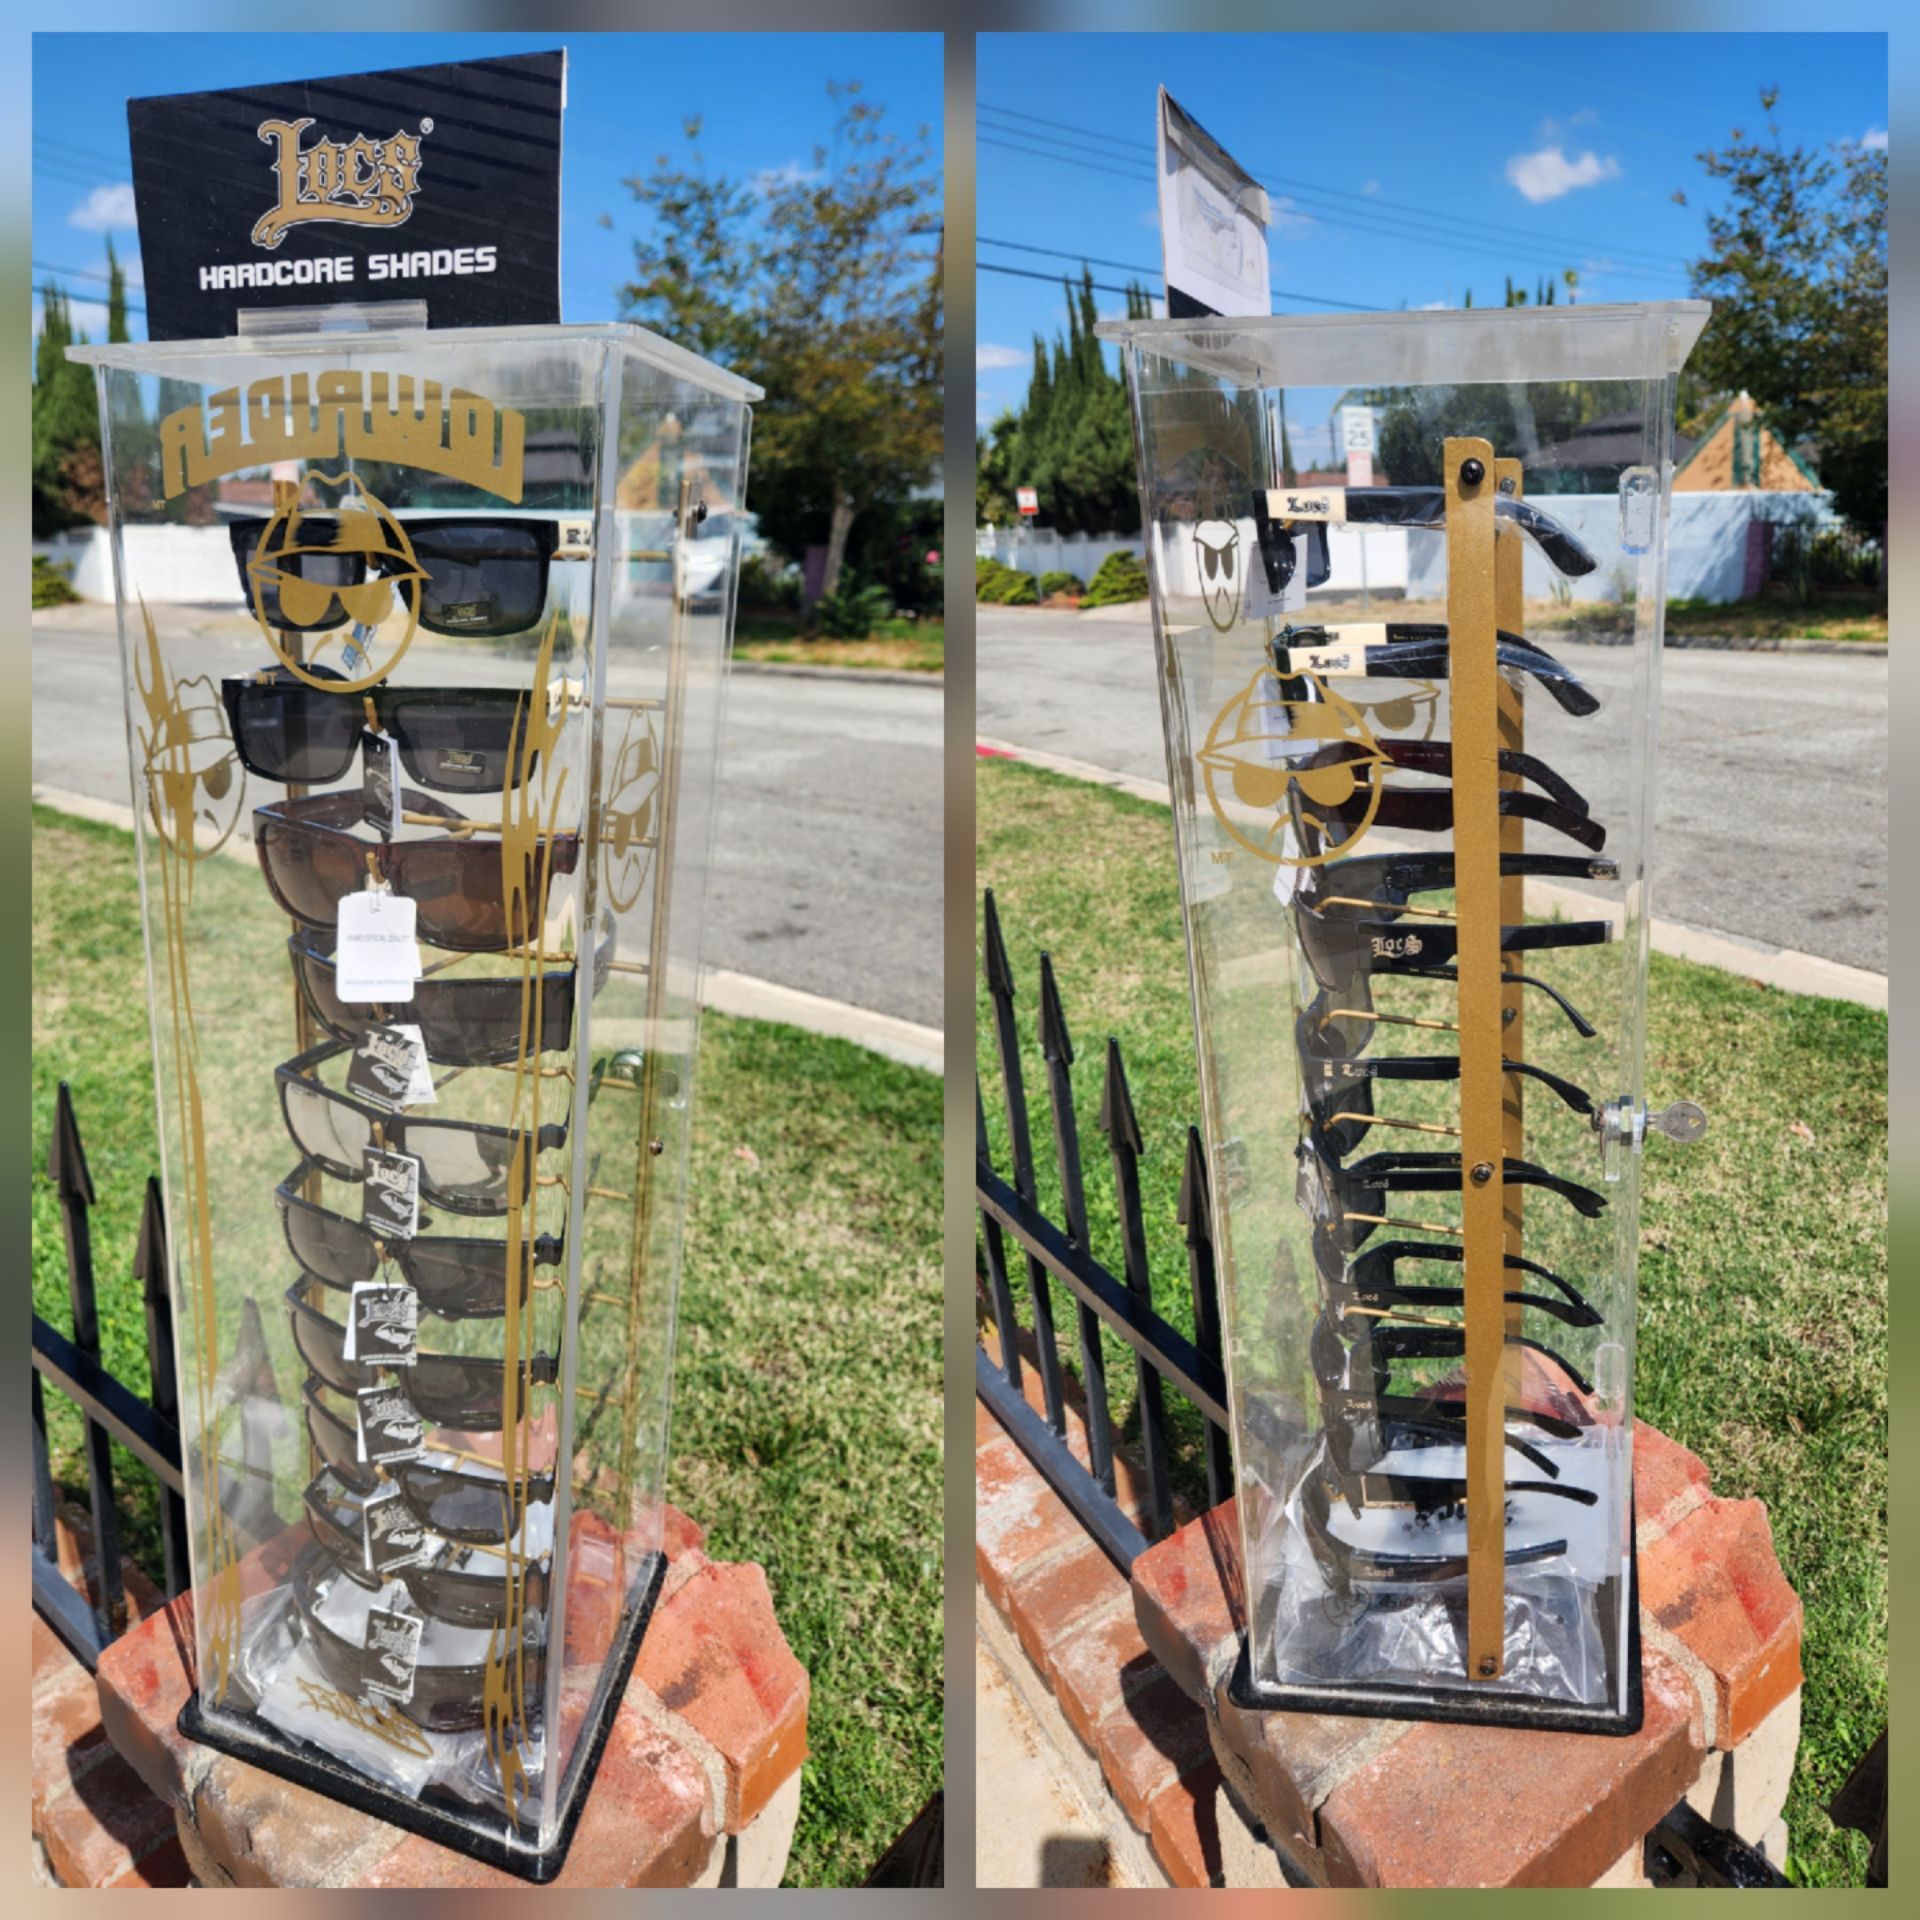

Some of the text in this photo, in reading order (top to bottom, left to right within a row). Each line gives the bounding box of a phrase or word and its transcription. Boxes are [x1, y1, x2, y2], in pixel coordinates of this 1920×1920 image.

[252, 117, 423, 250] Locs
[199, 247, 497, 290] HARDCORE SHADES
[1347, 429, 1371, 448] 25
